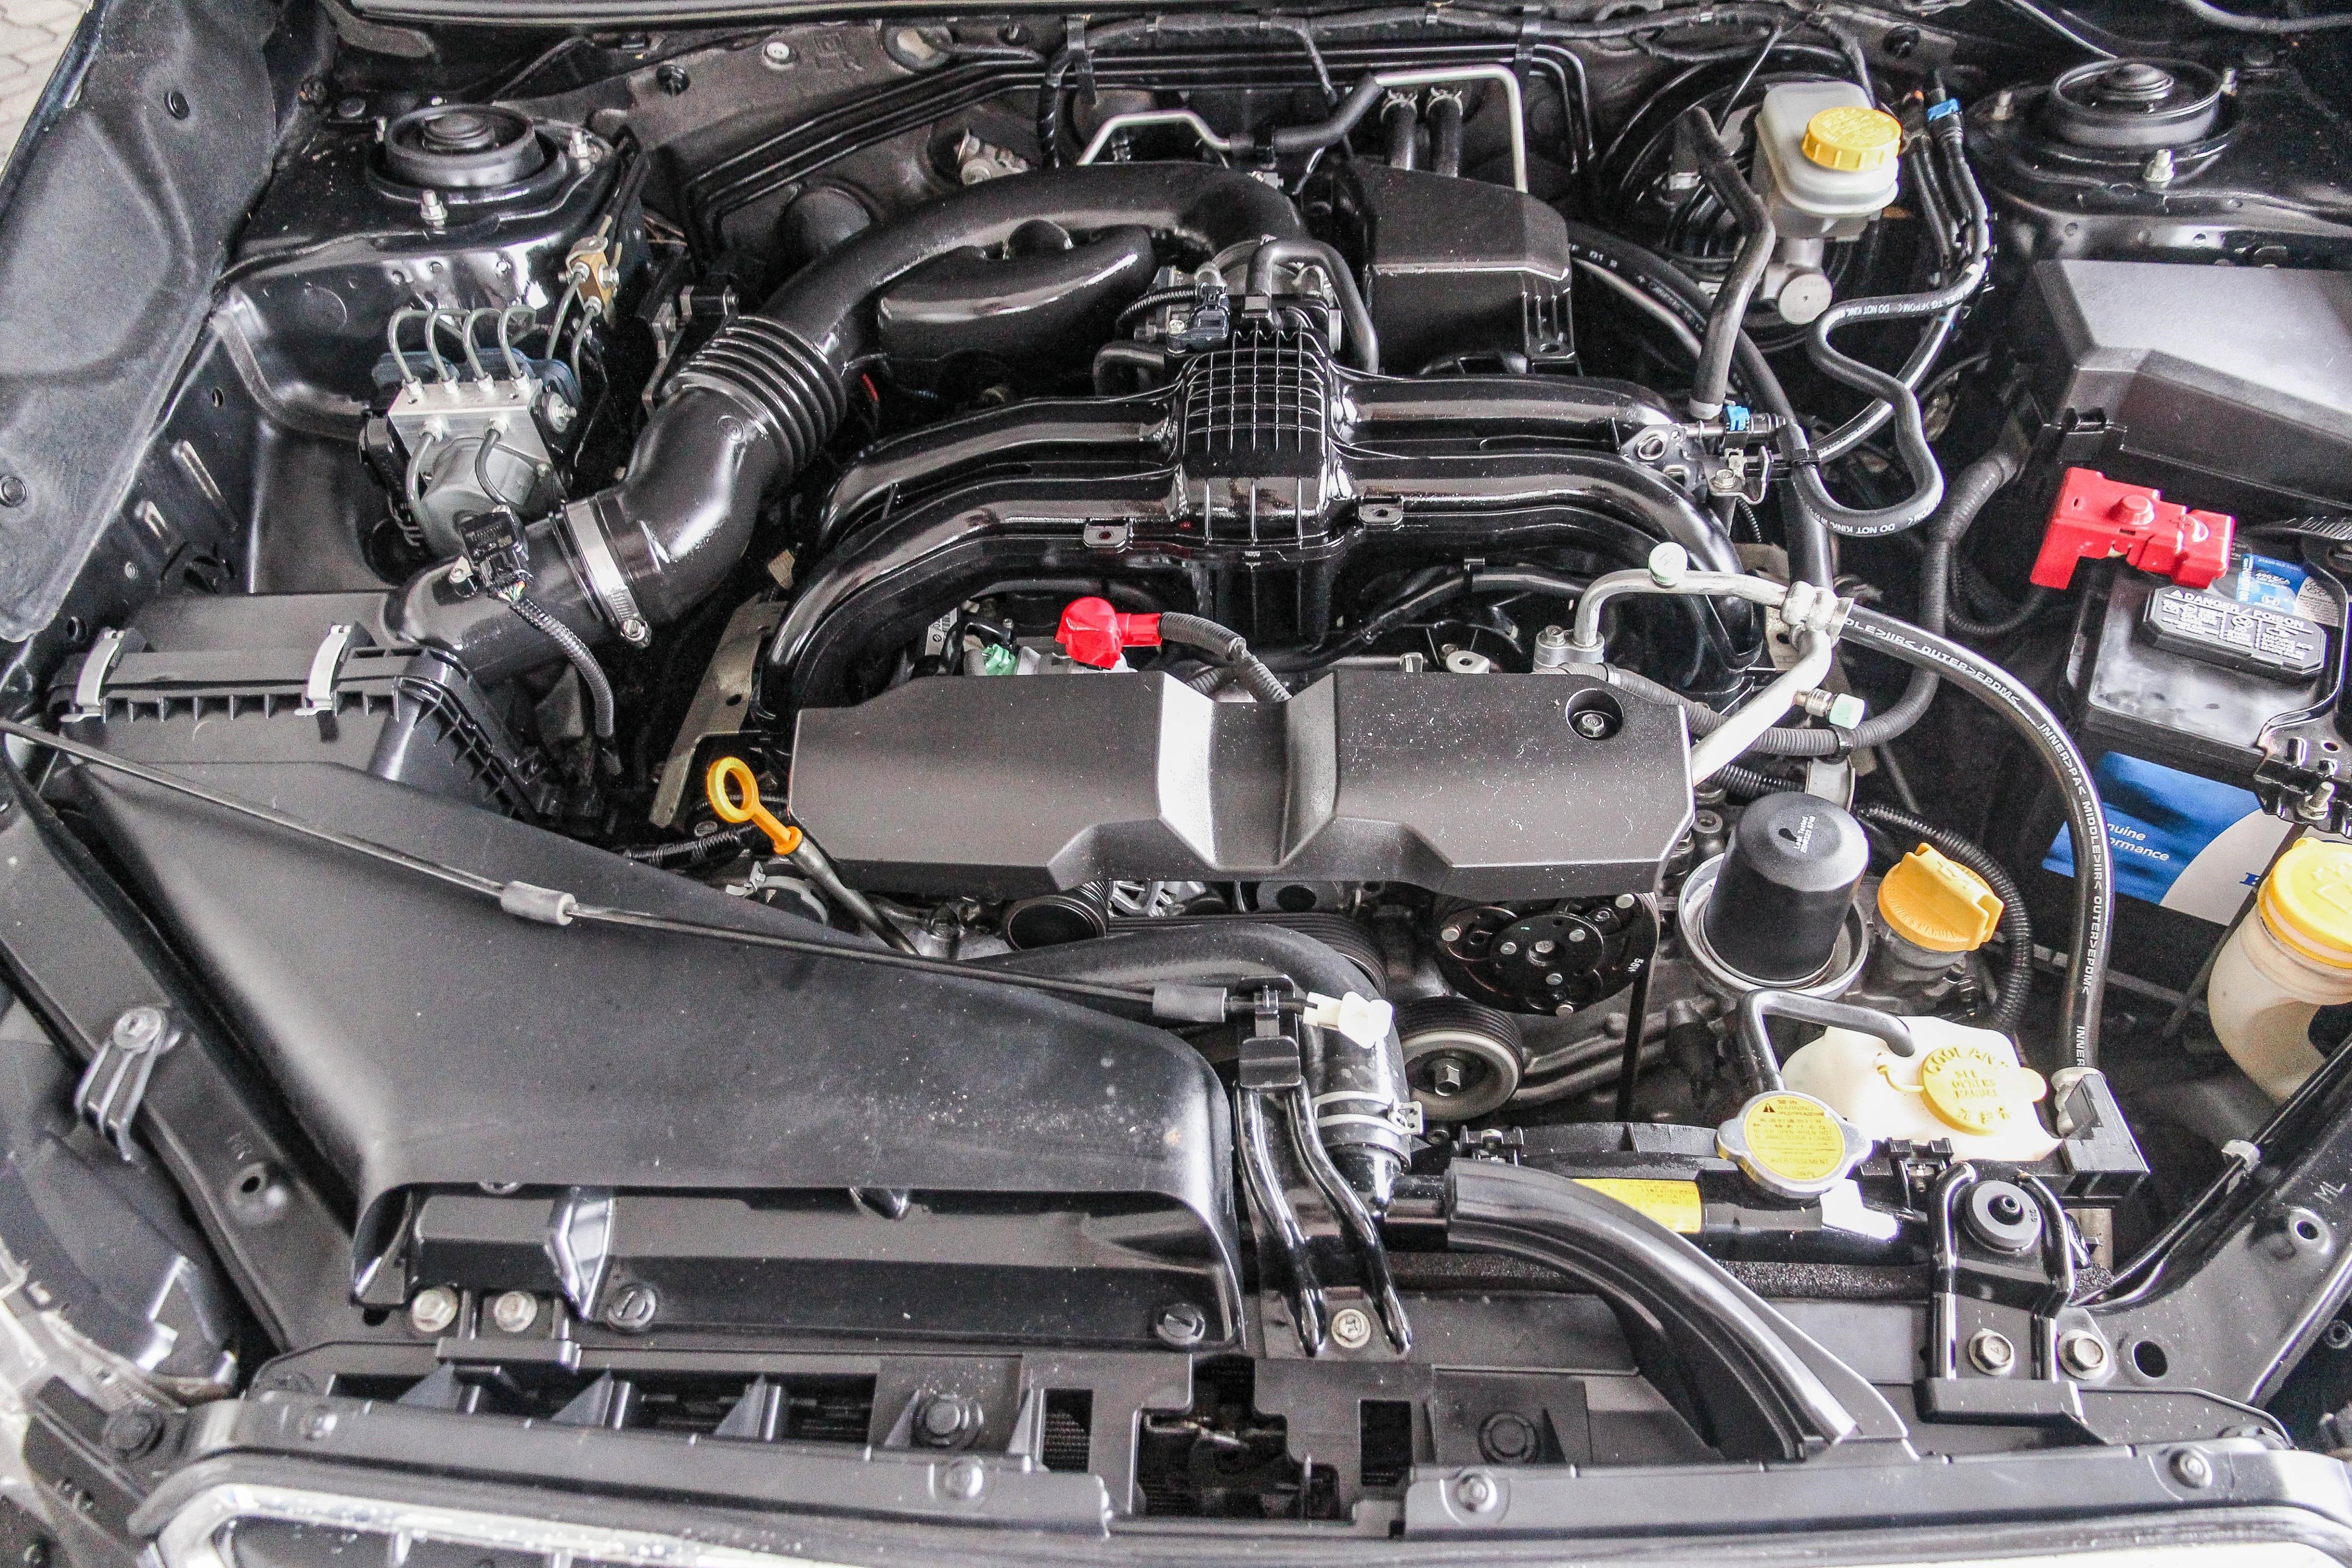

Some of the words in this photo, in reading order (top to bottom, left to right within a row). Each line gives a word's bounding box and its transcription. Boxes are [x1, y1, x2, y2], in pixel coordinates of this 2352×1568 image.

[1855, 525, 1877, 534] NOT
[1879, 522, 1896, 532] DO
[2185, 591, 2240, 612] DANGER
[2253, 610, 2305, 629] POISON
[2107, 822, 2146, 841] nuine
[2110, 836, 2170, 861] ormance
